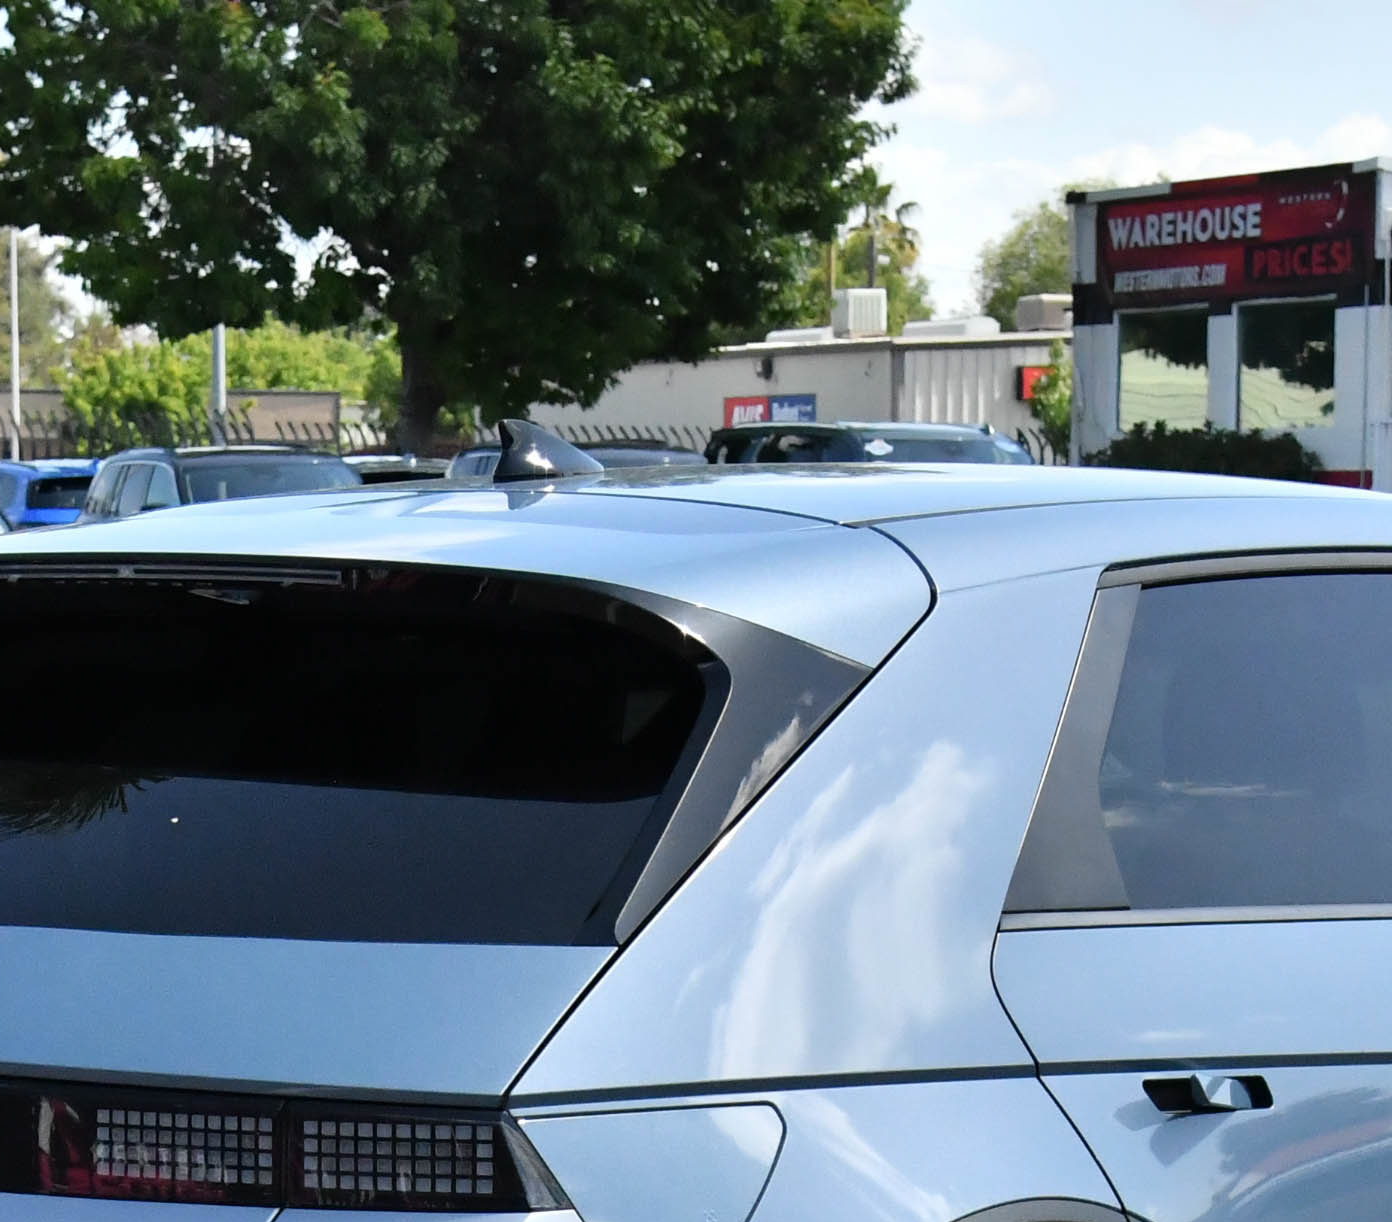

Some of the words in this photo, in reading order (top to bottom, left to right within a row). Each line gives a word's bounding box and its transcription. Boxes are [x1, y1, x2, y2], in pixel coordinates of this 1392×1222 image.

[1108, 202, 1262, 251] WAREHOUSE
[1114, 263, 1228, 293] WESTERNMOTORS.COM
[1253, 239, 1353, 279] PRICES!
